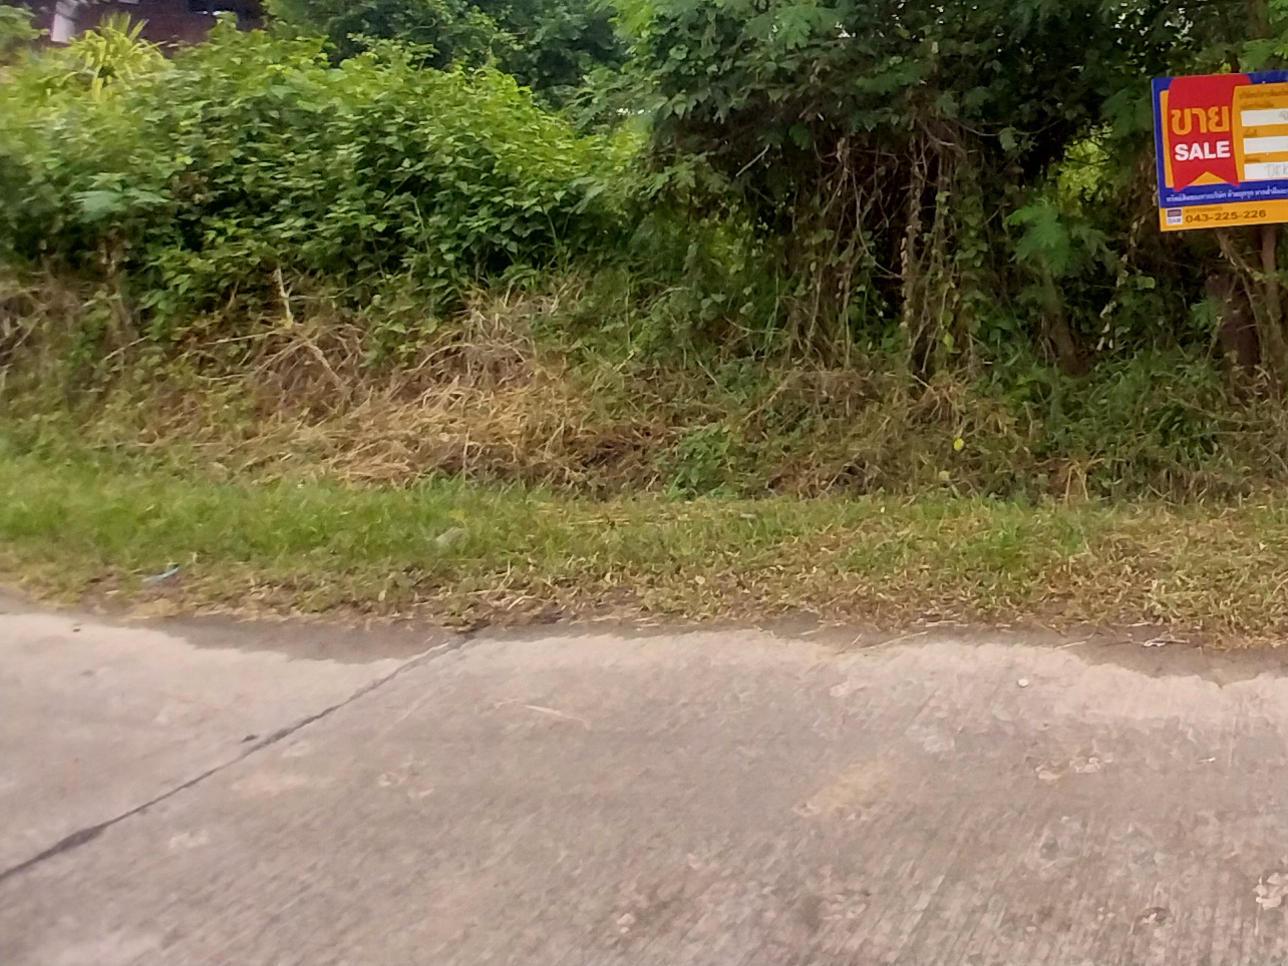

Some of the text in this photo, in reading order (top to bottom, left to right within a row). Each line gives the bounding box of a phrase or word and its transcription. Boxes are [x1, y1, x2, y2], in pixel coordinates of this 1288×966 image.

[1171, 106, 1230, 135] ขาย
[1174, 141, 1230, 161] SALE
[1185, 209, 1267, 223] 043-225-226
